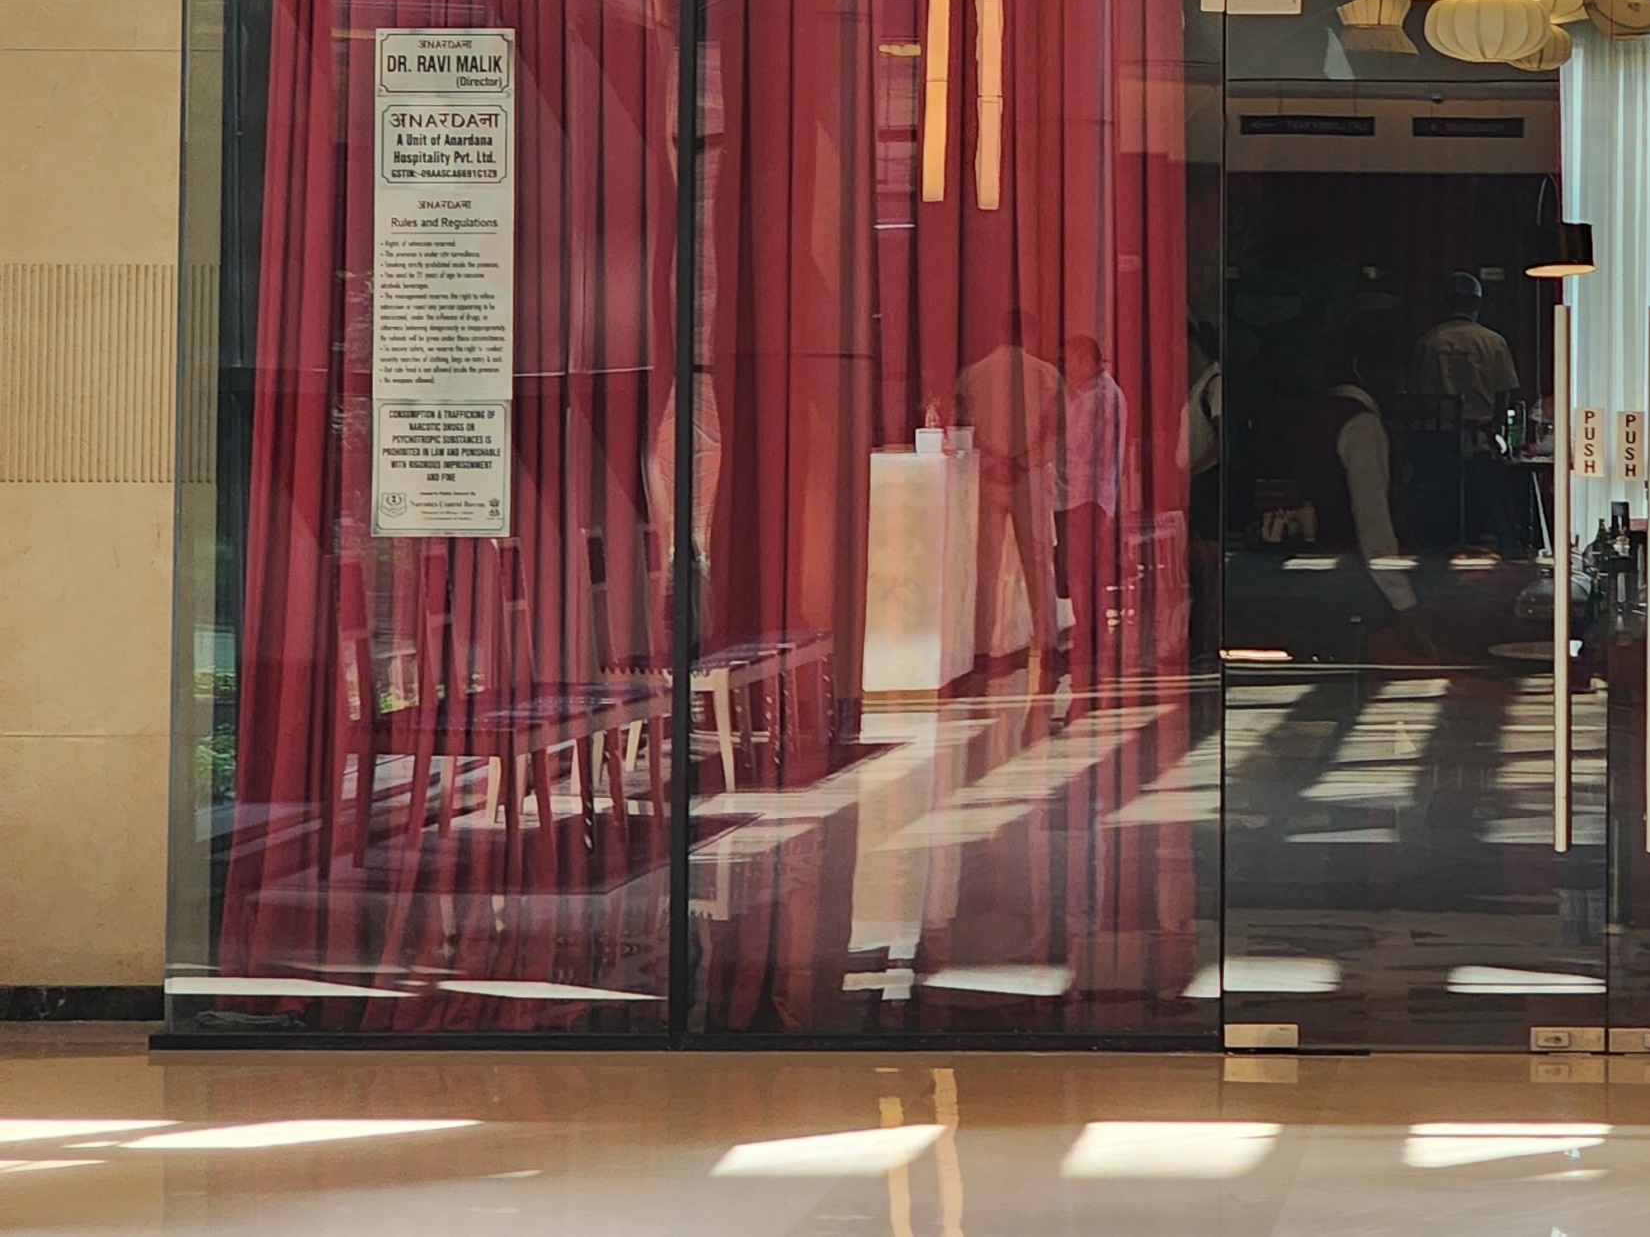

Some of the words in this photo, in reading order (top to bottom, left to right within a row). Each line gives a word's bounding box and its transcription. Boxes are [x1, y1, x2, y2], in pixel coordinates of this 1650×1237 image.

[387, 55, 412, 73] DR.
[417, 55, 451, 73] RAVI
[456, 55, 503, 73] MALIK
[456, 76, 503, 90] (Director)
[396, 134, 404, 148] A
[406, 134, 428, 148] Unit
[431, 134, 442, 148] of
[444, 134, 494, 148] Anardana
[393, 151, 451, 166] Hospitality
[454, 151, 474, 164] Pvt.
[477, 151, 497, 164] Ltd.
[391, 217, 419, 229] Rules
[421, 217, 439, 229] and
[441, 217, 499, 231] Regulations
[1584, 410, 1596, 474] PUSH
[1624, 414, 1637, 478] PUSH
